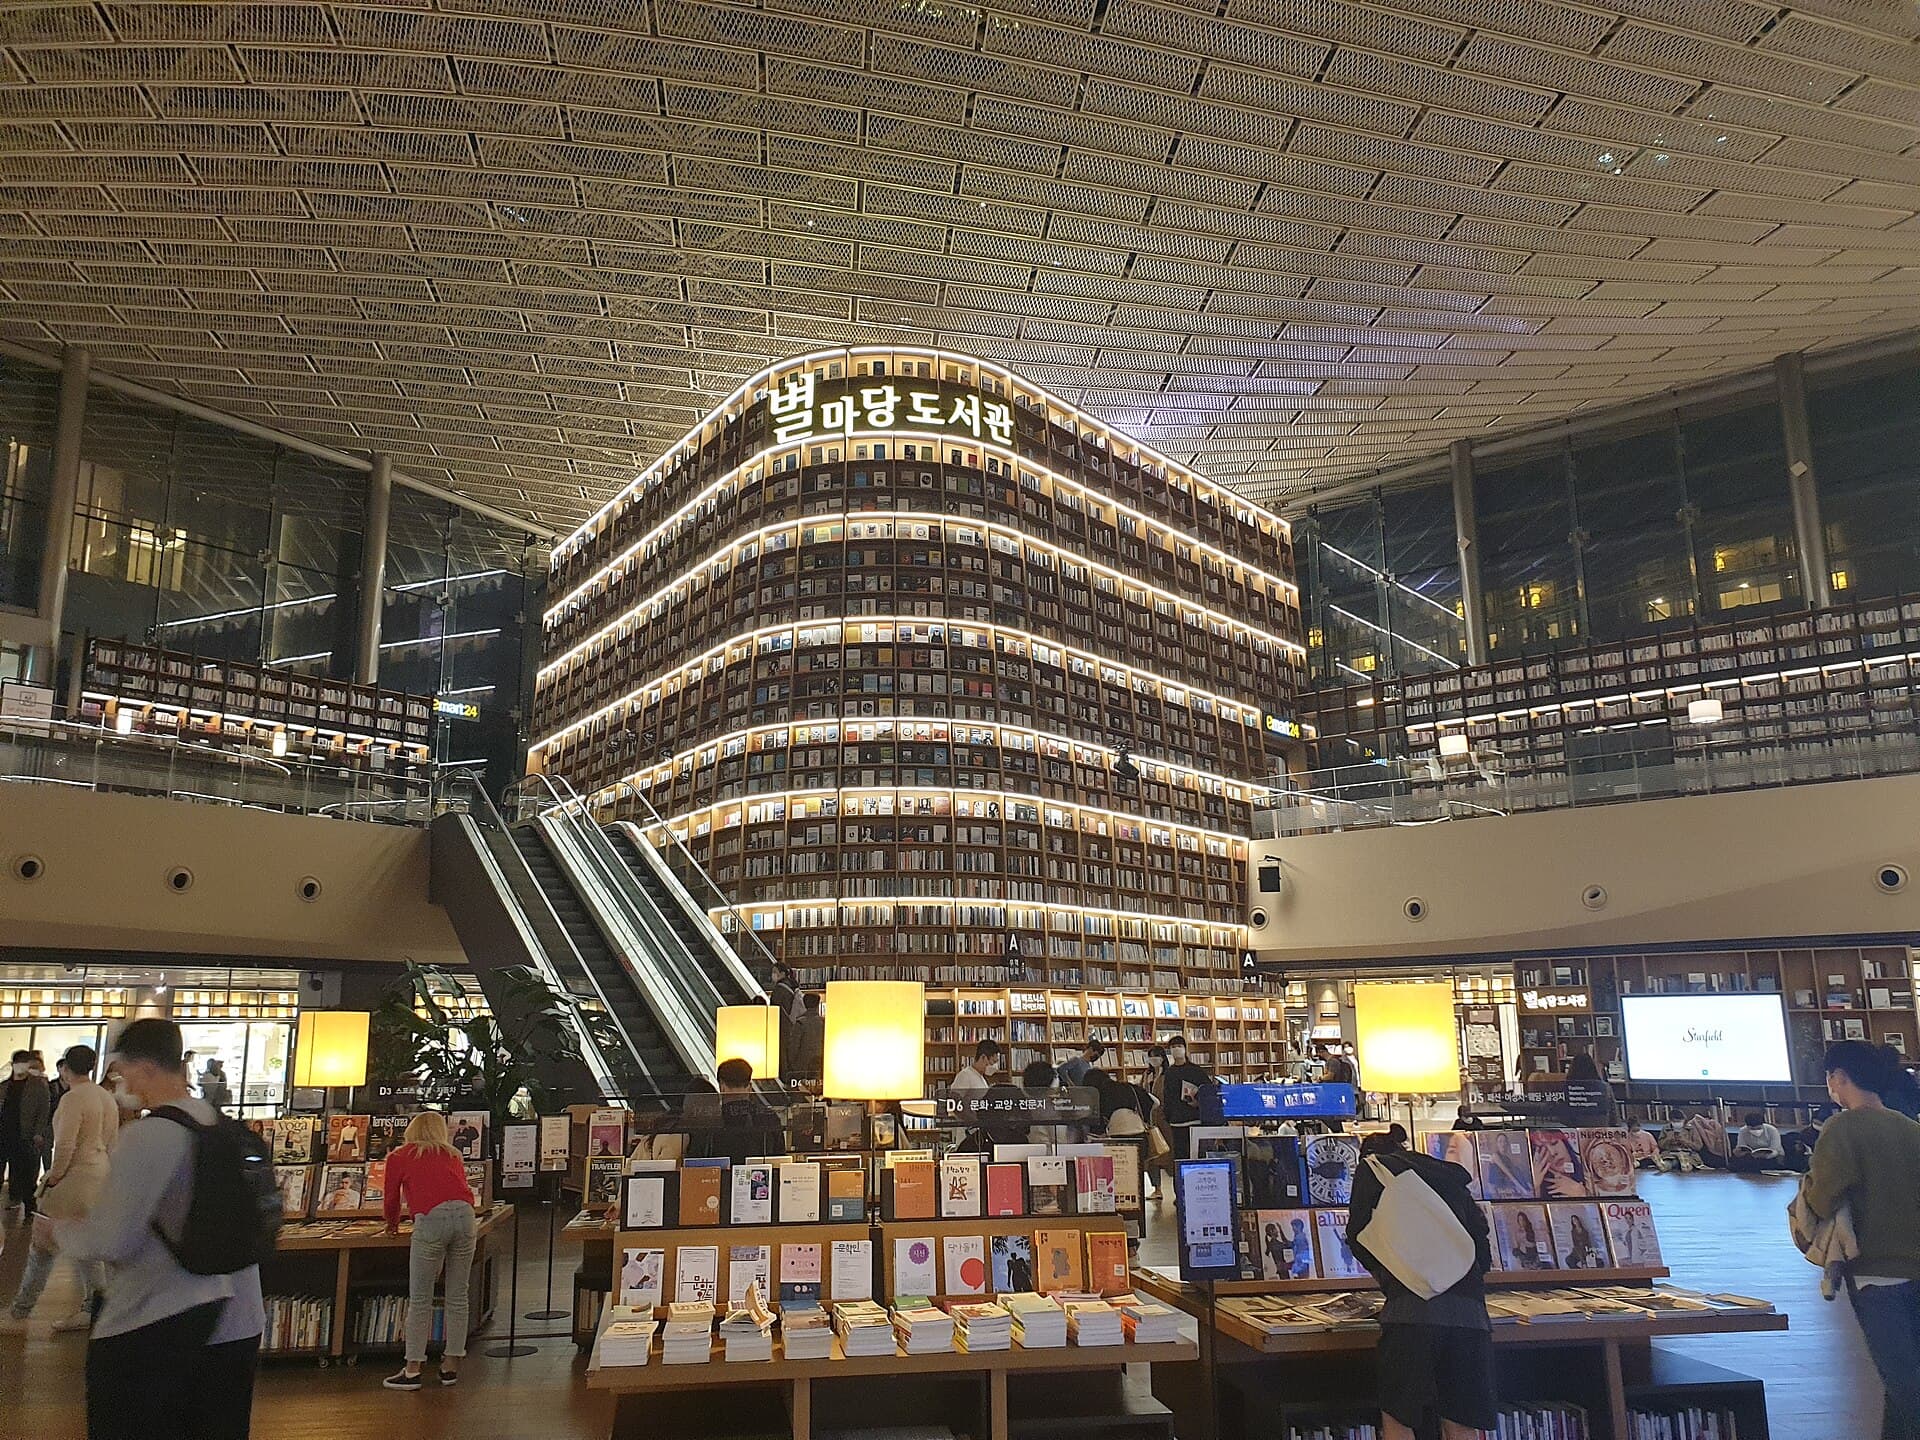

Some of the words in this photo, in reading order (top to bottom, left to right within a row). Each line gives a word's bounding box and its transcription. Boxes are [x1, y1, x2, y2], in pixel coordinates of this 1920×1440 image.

[432, 698, 479, 718] emart24
[1266, 714, 1300, 739] emart24
[1009, 933, 1018, 951] A
[1243, 952, 1255, 967] A
[1682, 1027, 1723, 1049] Starfield
[379, 1086, 392, 1096] D3
[1469, 1093, 1484, 1104] D5
[946, 1098, 964, 1112] D6
[969, 1098, 1046, 1111] 문화·교양·전문지
[1318, 1211, 1350, 1227] allu
[1607, 1202, 1651, 1220] Queen
